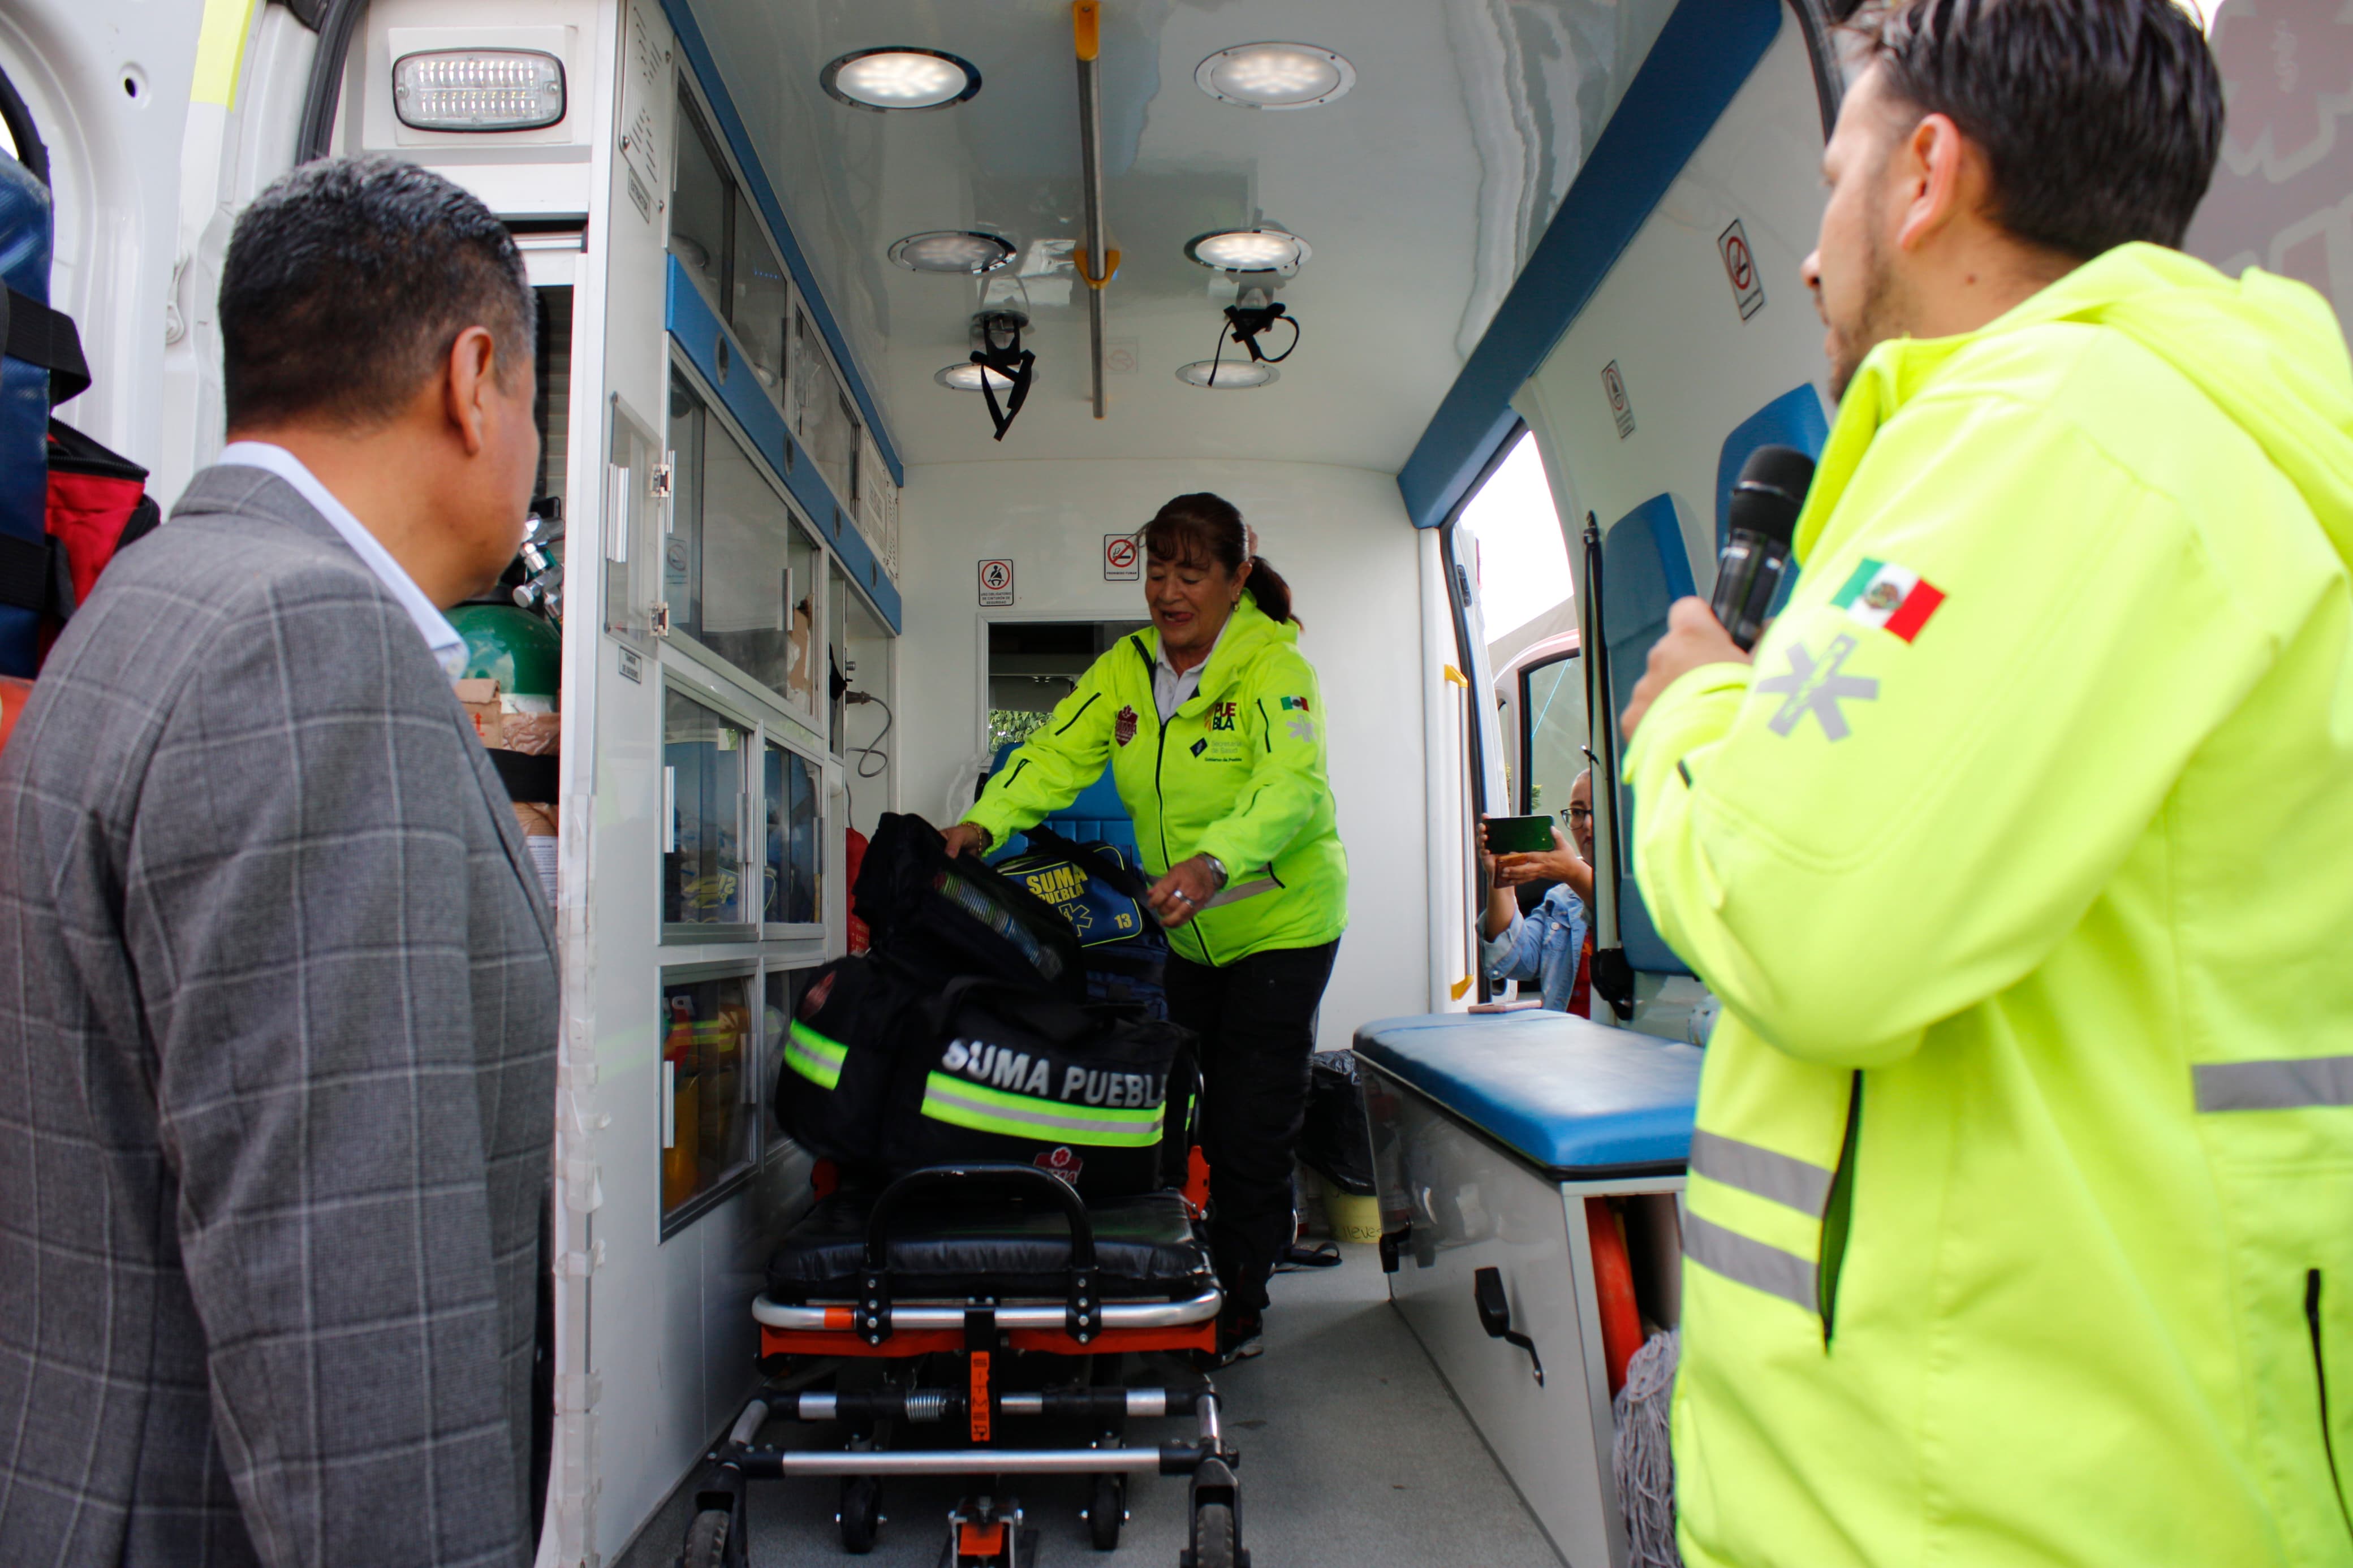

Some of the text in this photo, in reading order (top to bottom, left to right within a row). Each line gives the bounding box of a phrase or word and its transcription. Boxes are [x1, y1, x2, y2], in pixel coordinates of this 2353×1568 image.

[1026, 866, 1088, 895] SUMA
[1114, 913, 1132, 929] 13
[942, 1038, 1050, 1096] SUMA
